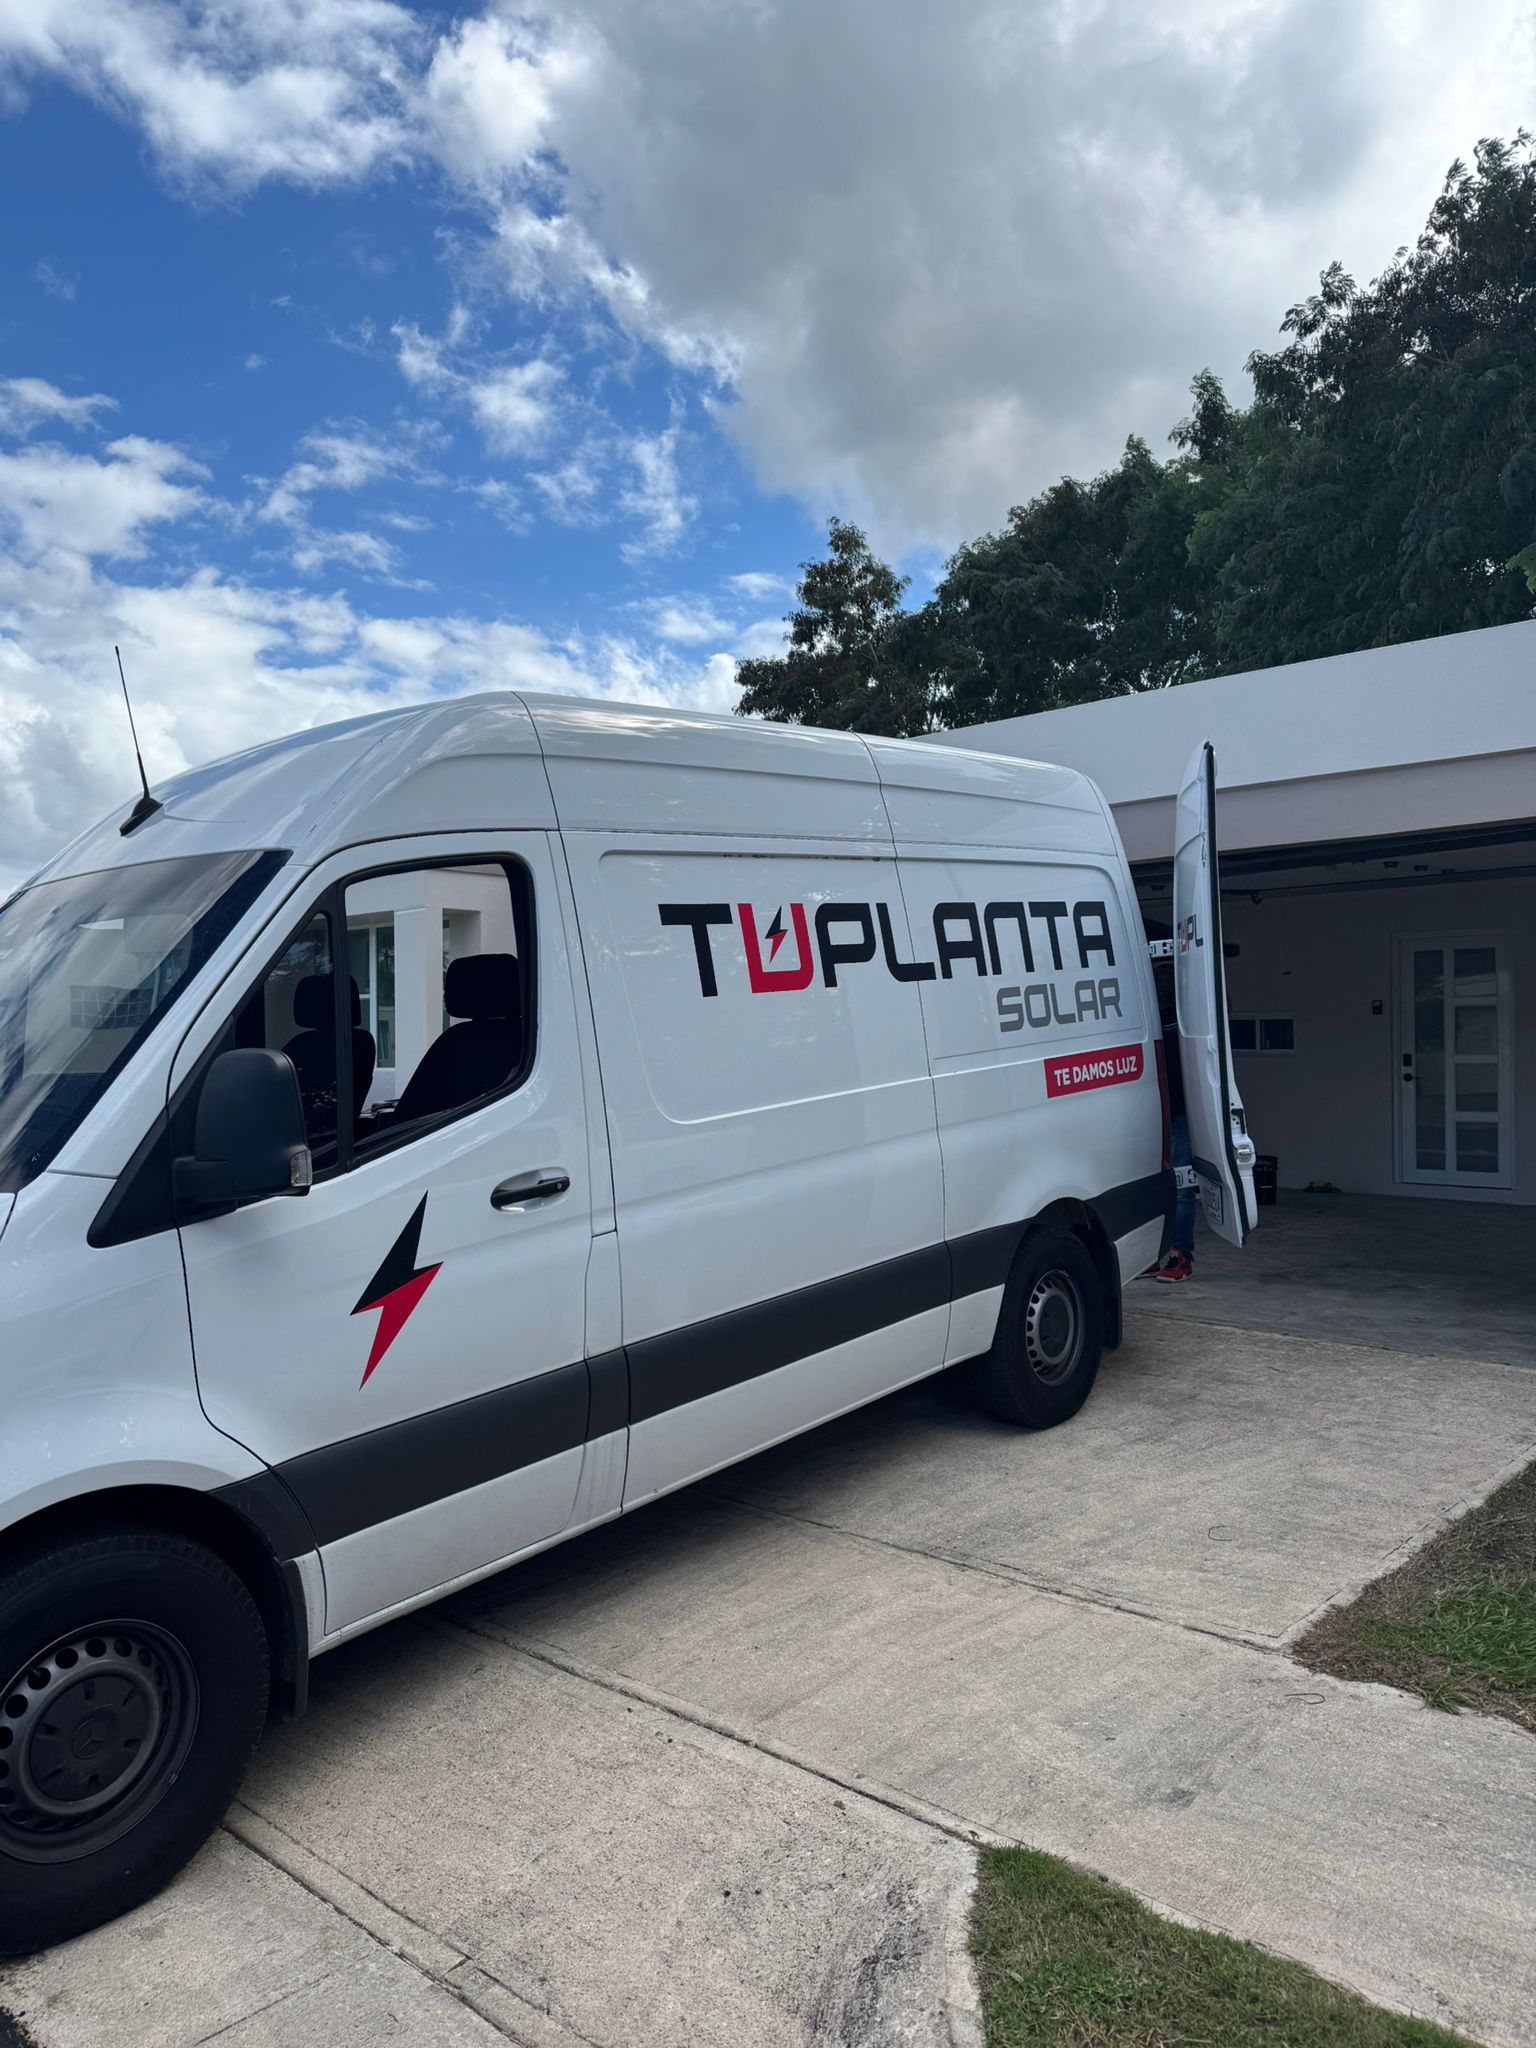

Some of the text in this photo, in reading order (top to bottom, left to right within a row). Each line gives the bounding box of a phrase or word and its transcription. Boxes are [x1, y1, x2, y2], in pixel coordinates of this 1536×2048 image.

[996, 978, 1123, 1033] SOLAR
[1054, 1056, 1138, 1087] TE DAMOS LUZ
